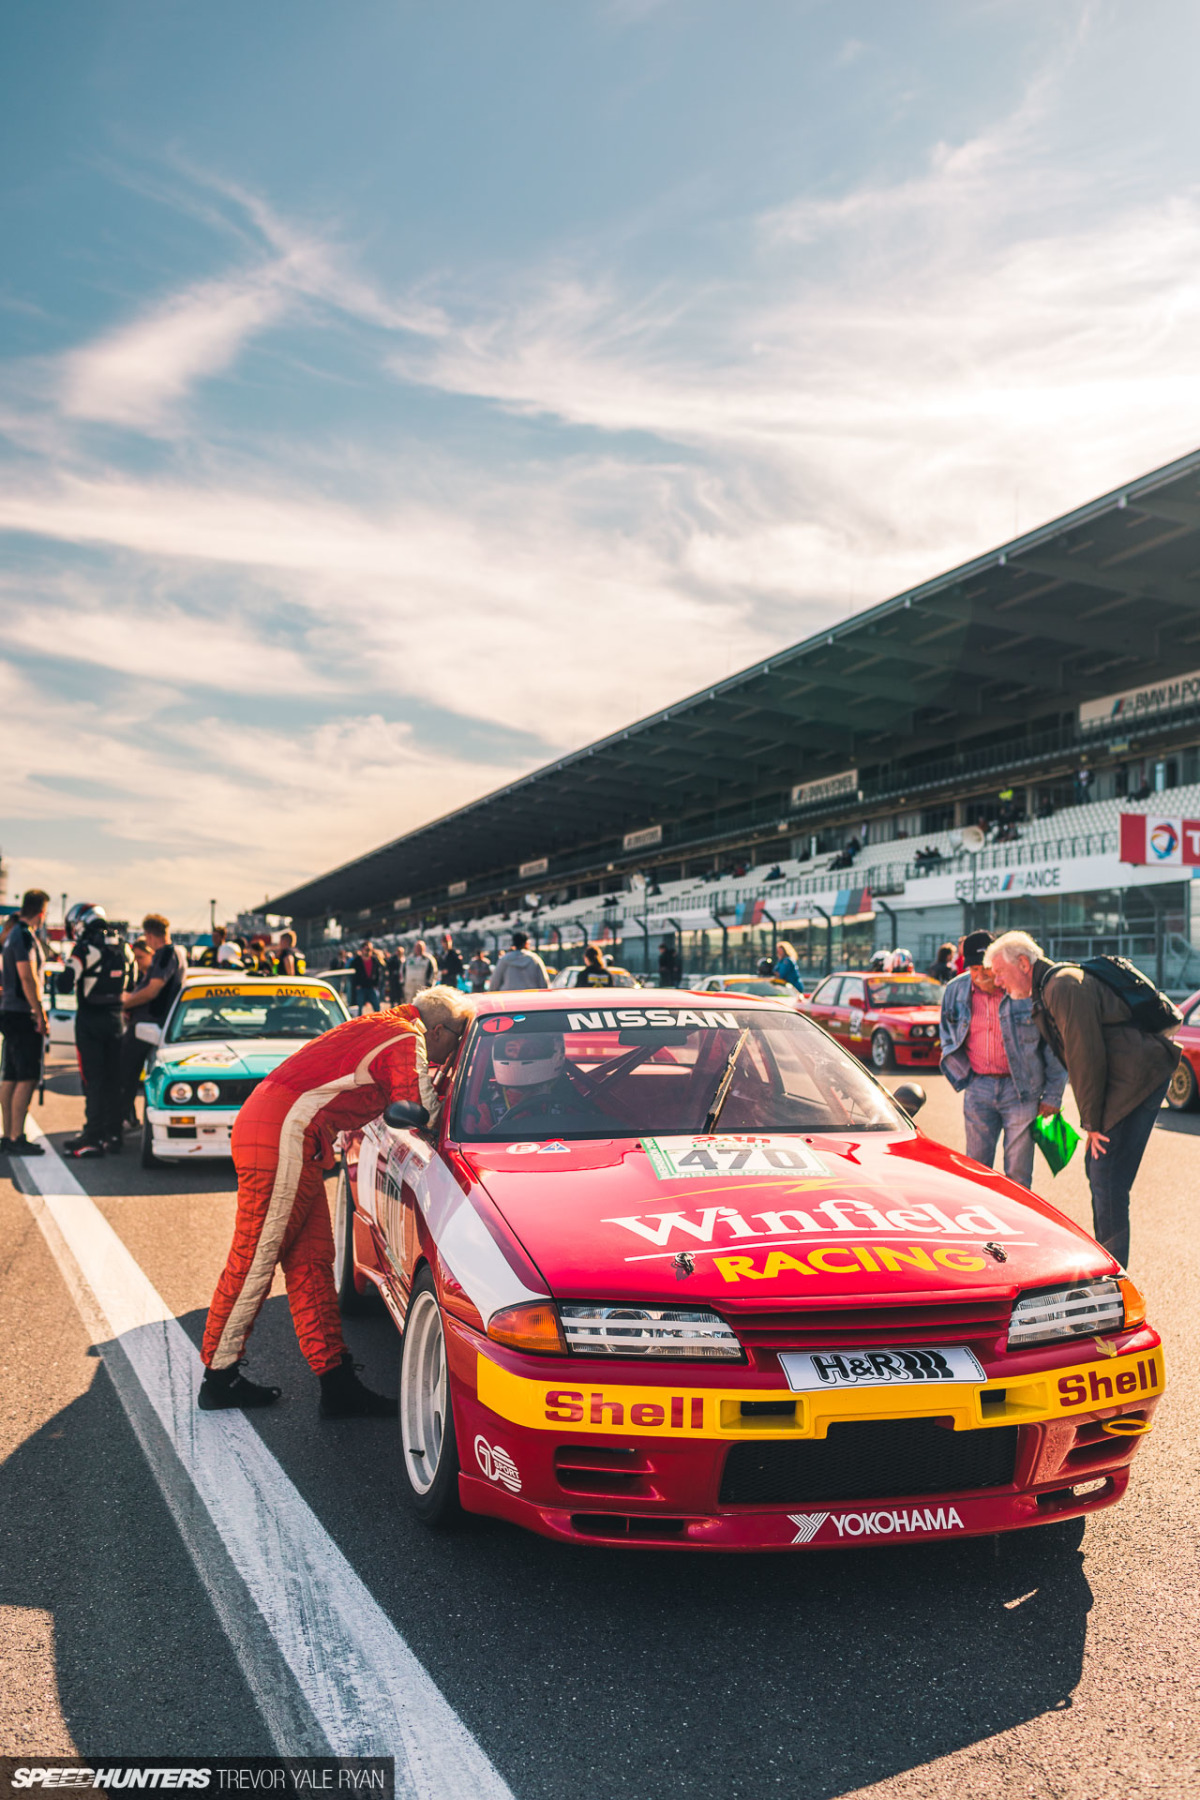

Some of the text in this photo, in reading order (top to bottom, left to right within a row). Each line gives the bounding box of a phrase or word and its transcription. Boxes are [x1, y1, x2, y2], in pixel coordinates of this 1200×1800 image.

[205, 987, 240, 998] ADAC
[276, 987, 310, 997] ADAC
[567, 1010, 739, 1031] NISSAN
[678, 1149, 808, 1171] 470
[600, 1199, 1025, 1247] Winfield
[712, 1246, 987, 1283] RACING
[814, 1354, 906, 1379] H&R
[1058, 1358, 1158, 1407] Shell
[545, 1391, 704, 1429] Shell
[493, 1459, 519, 1479] SPORT
[831, 1507, 964, 1537] YOKOHAMA
